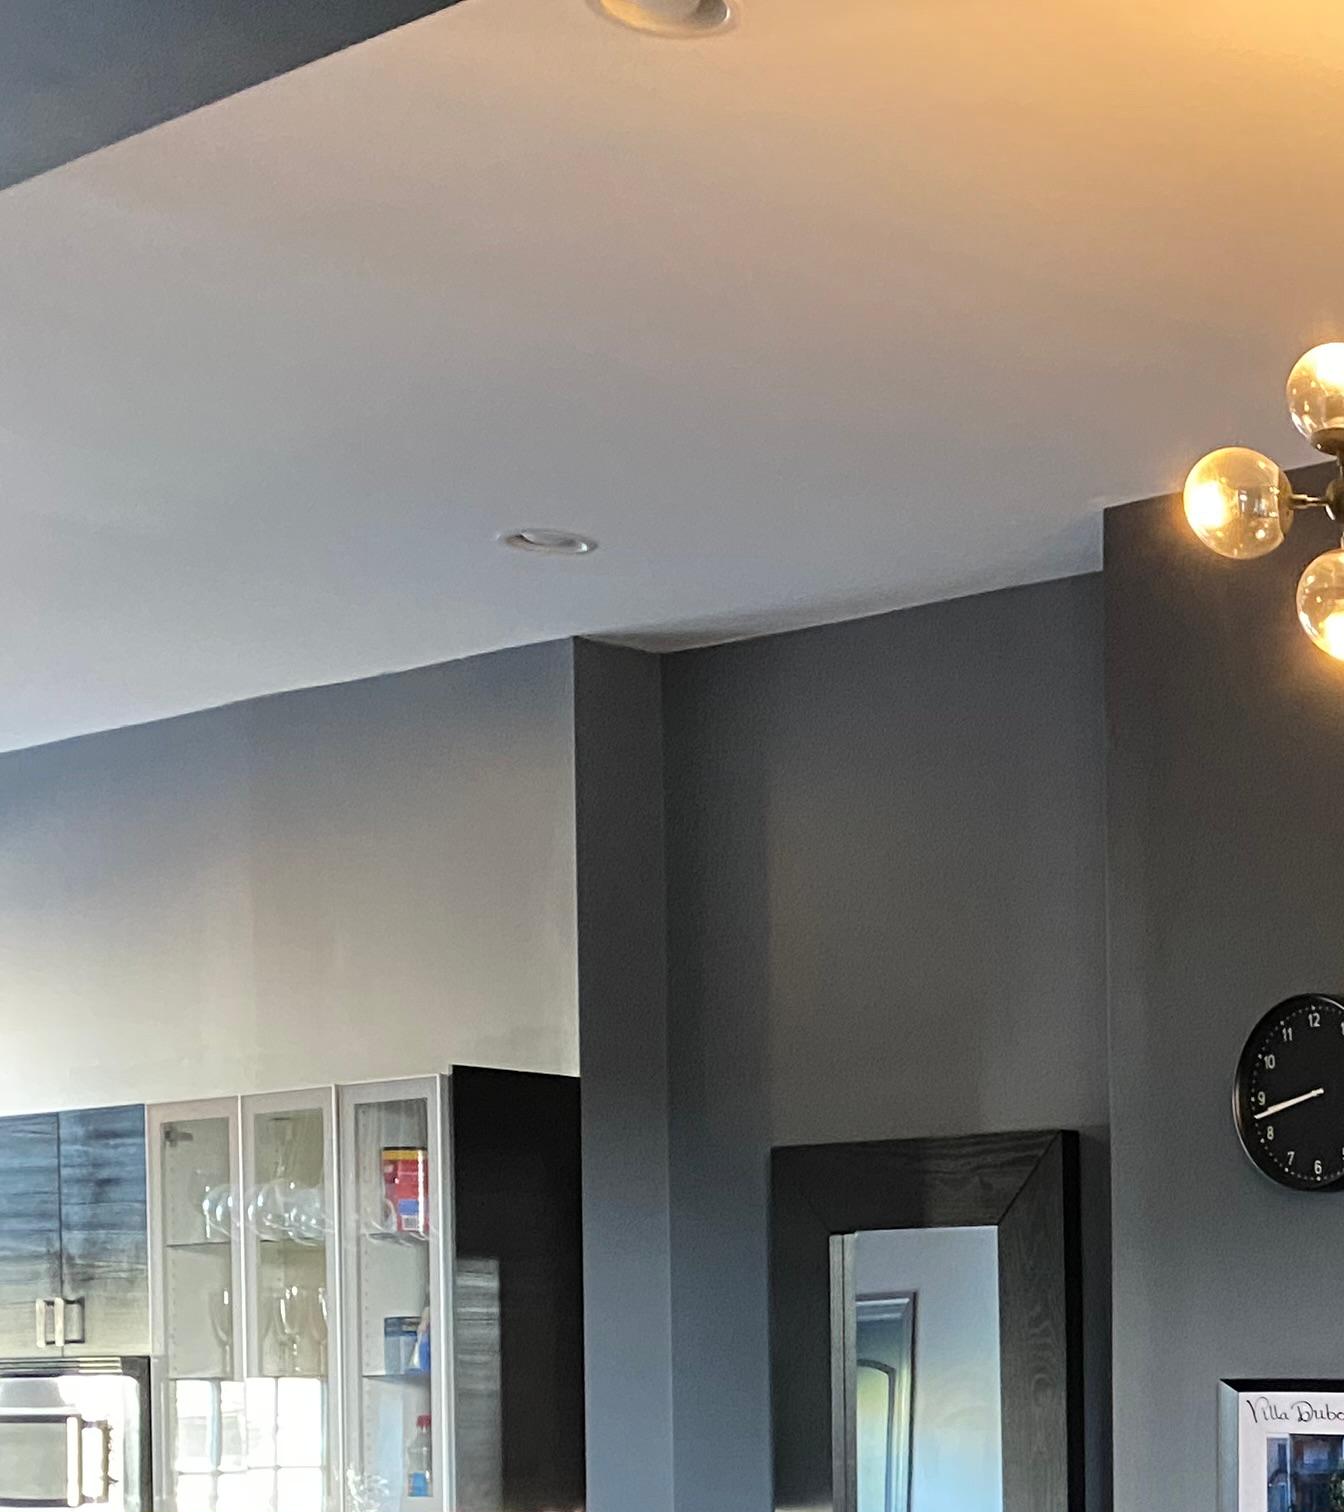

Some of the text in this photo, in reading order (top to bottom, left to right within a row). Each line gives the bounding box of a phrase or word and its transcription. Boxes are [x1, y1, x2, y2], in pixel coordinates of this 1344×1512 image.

[1308, 1013, 1321, 1028] 12
[1282, 1027, 1293, 1042] 11
[1263, 1054, 1276, 1070] 10
[1257, 1091, 1266, 1106] 9
[1266, 1126, 1275, 1141] 8
[1287, 1151, 1295, 1166] 7
[1314, 1160, 1323, 1175] 6
